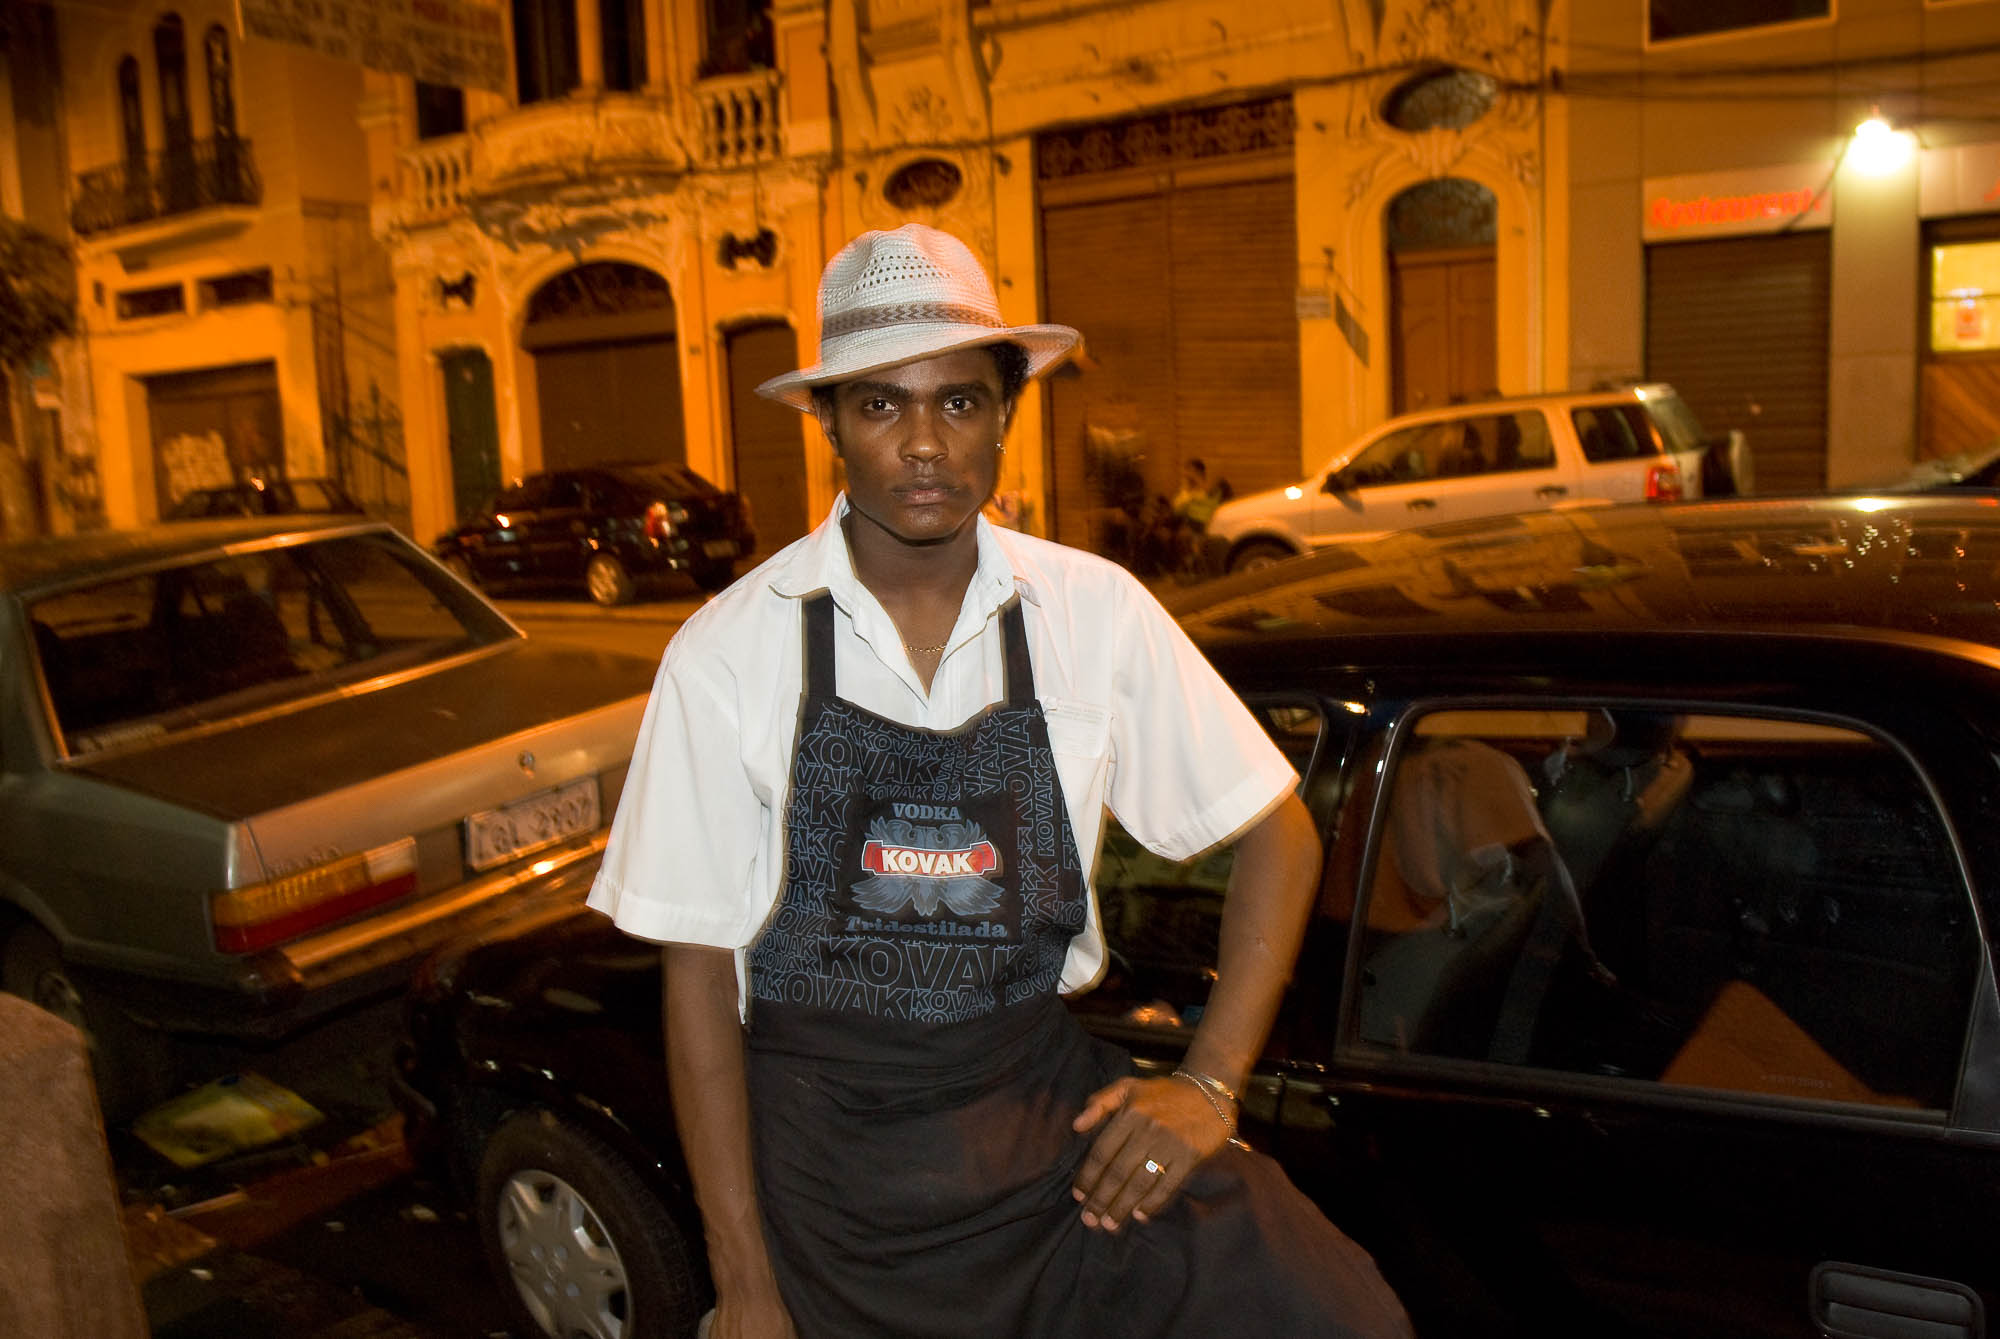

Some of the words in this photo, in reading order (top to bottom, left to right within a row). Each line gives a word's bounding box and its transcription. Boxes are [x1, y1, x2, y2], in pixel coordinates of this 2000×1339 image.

[892, 803, 961, 820] VODKA
[1035, 766, 1056, 857] KOVAK
[882, 850, 973, 875] KOVAK
[846, 916, 1008, 937] Tridestilada
